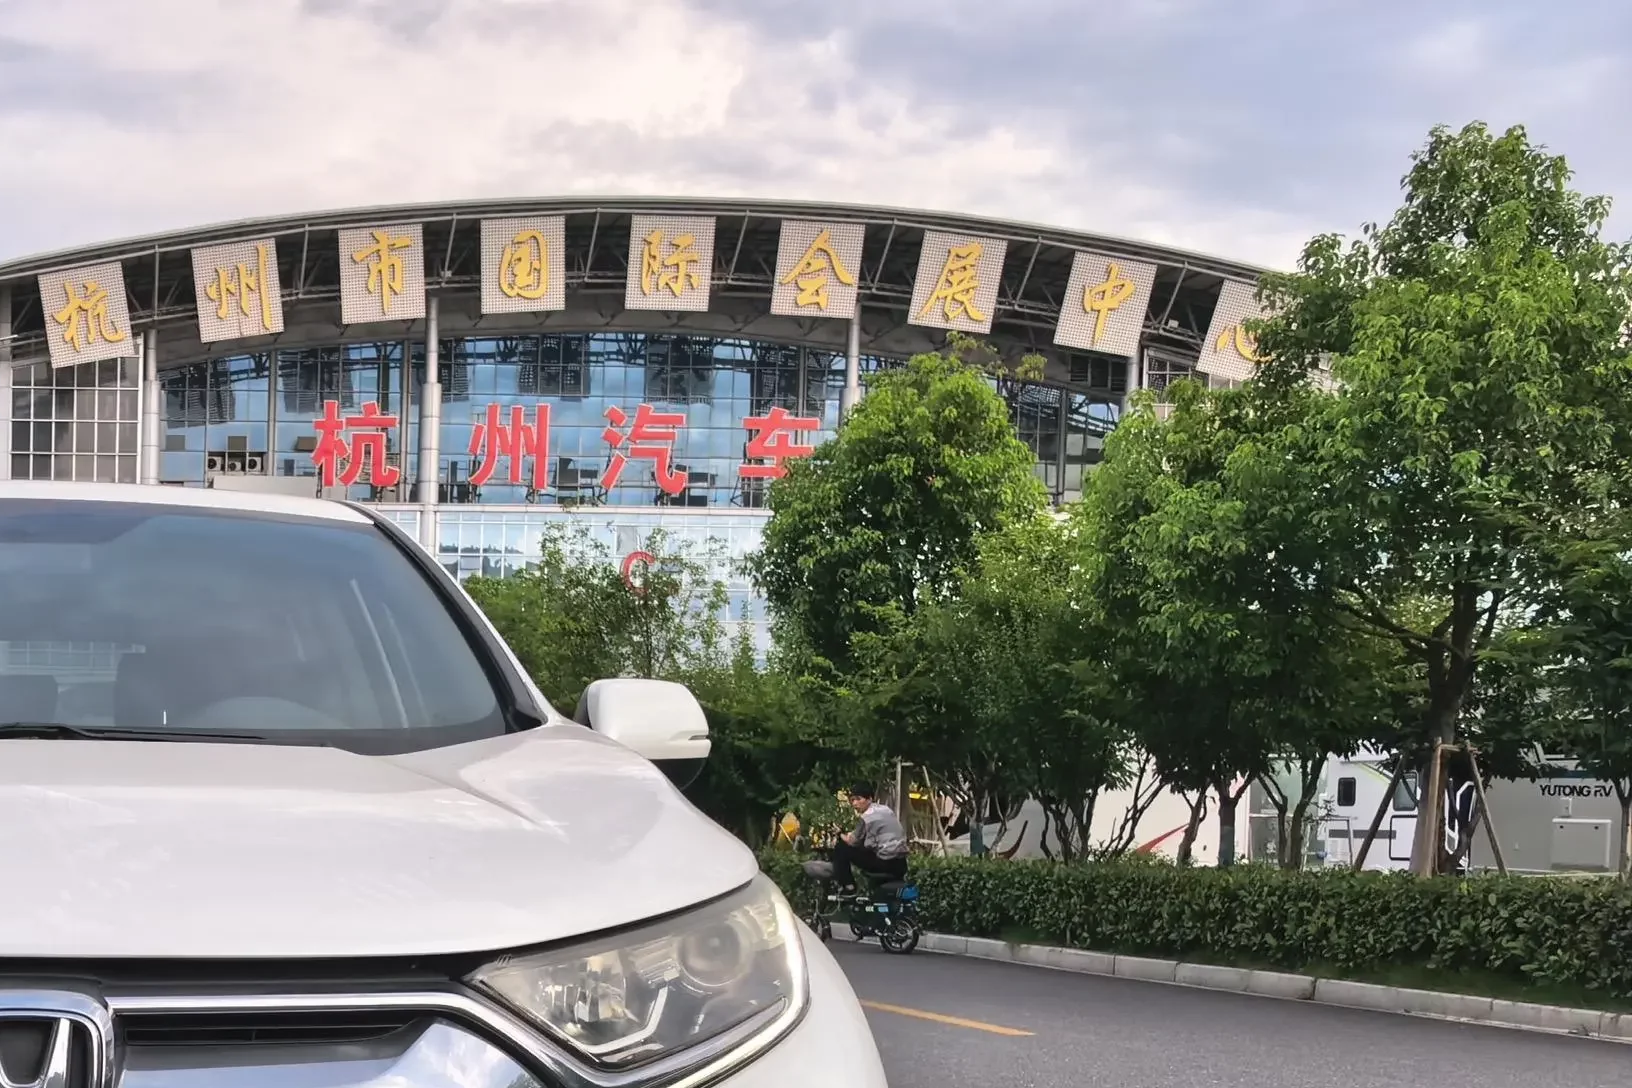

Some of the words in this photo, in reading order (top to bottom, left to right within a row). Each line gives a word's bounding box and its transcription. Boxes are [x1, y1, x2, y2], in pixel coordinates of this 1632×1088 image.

[311, 400, 821, 495] 杭州汽车
[1540, 784, 1591, 797] YUTONG
[1593, 784, 1613, 797] RV
